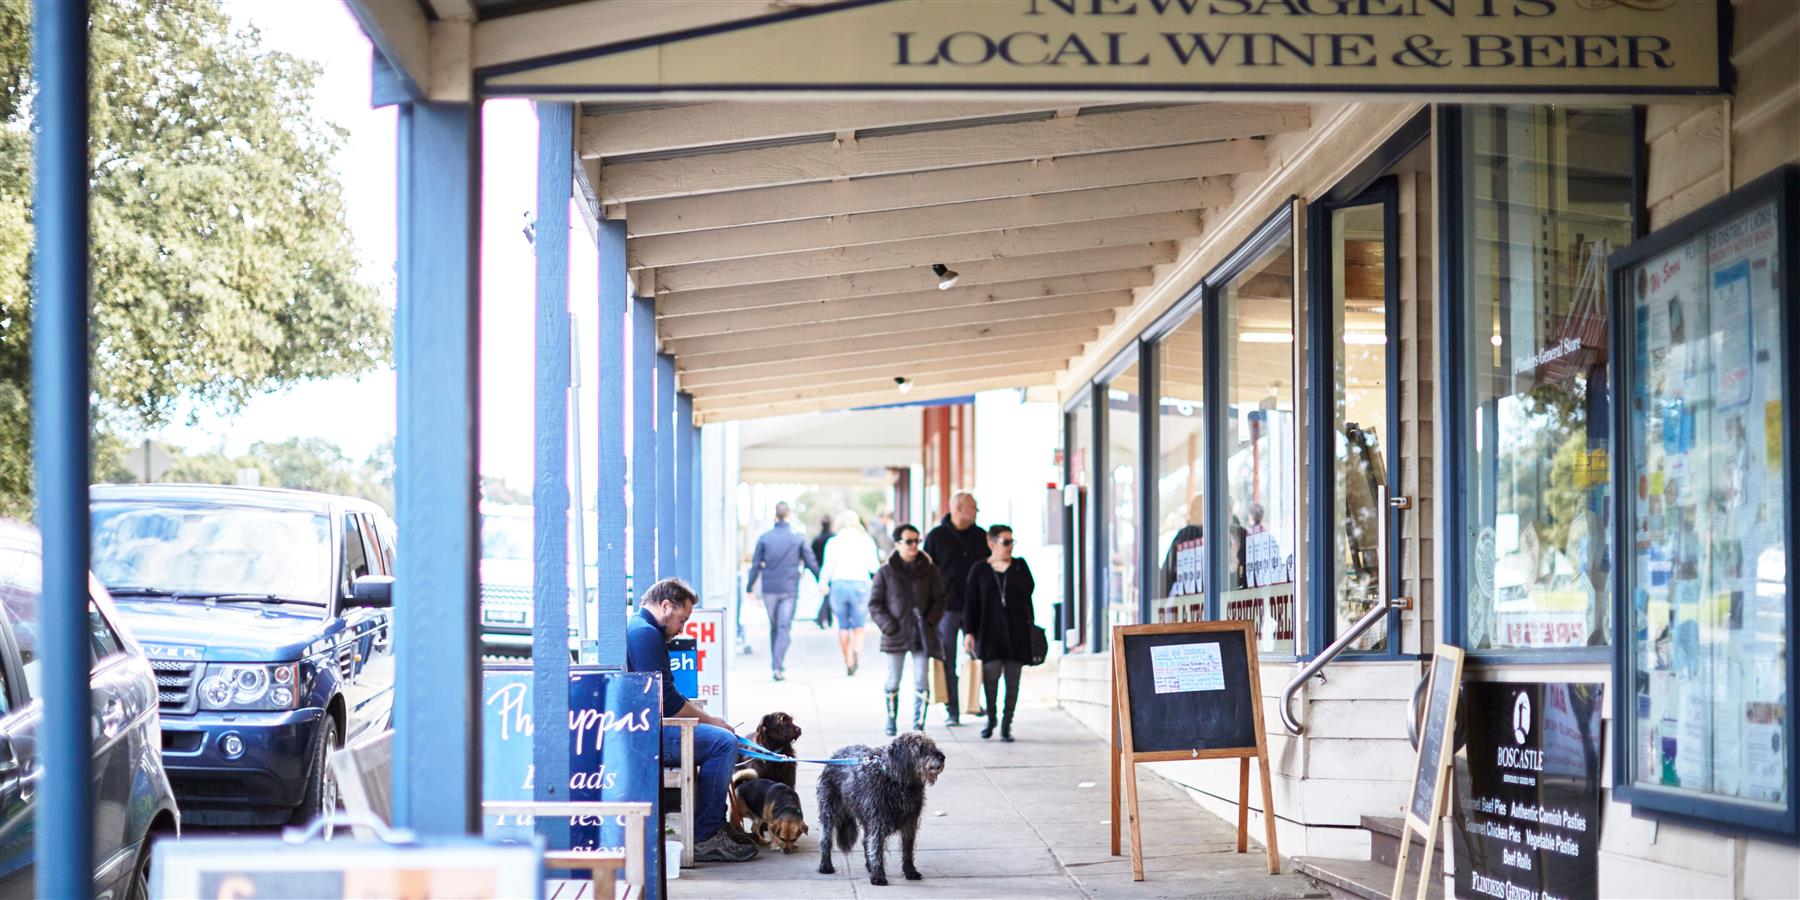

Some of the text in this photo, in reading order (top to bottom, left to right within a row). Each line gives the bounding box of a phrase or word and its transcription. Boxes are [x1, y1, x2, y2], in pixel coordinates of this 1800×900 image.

[890, 31, 1676, 69] LOCAL WINE & BEER
[1540, 339, 1563, 365] General
[1564, 337, 1581, 354] Store
[150, 646, 196, 657] VER
[1498, 746, 1544, 771] BOSCASTLE
[1482, 797, 1493, 813] Beef
[1494, 798, 1506, 816] Pies
[1511, 801, 1538, 821] Authentic
[1539, 806, 1561, 826] Cornish
[1563, 810, 1586, 832] Pasties
[1487, 820, 1508, 840] Chicken
[1508, 825, 1521, 843] Pies
[1526, 828, 1555, 851] Vegetable
[1556, 834, 1579, 857] Pasties
[1503, 848, 1532, 871] Beef Rolls
[1472, 871, 1505, 899] FLINDERS
